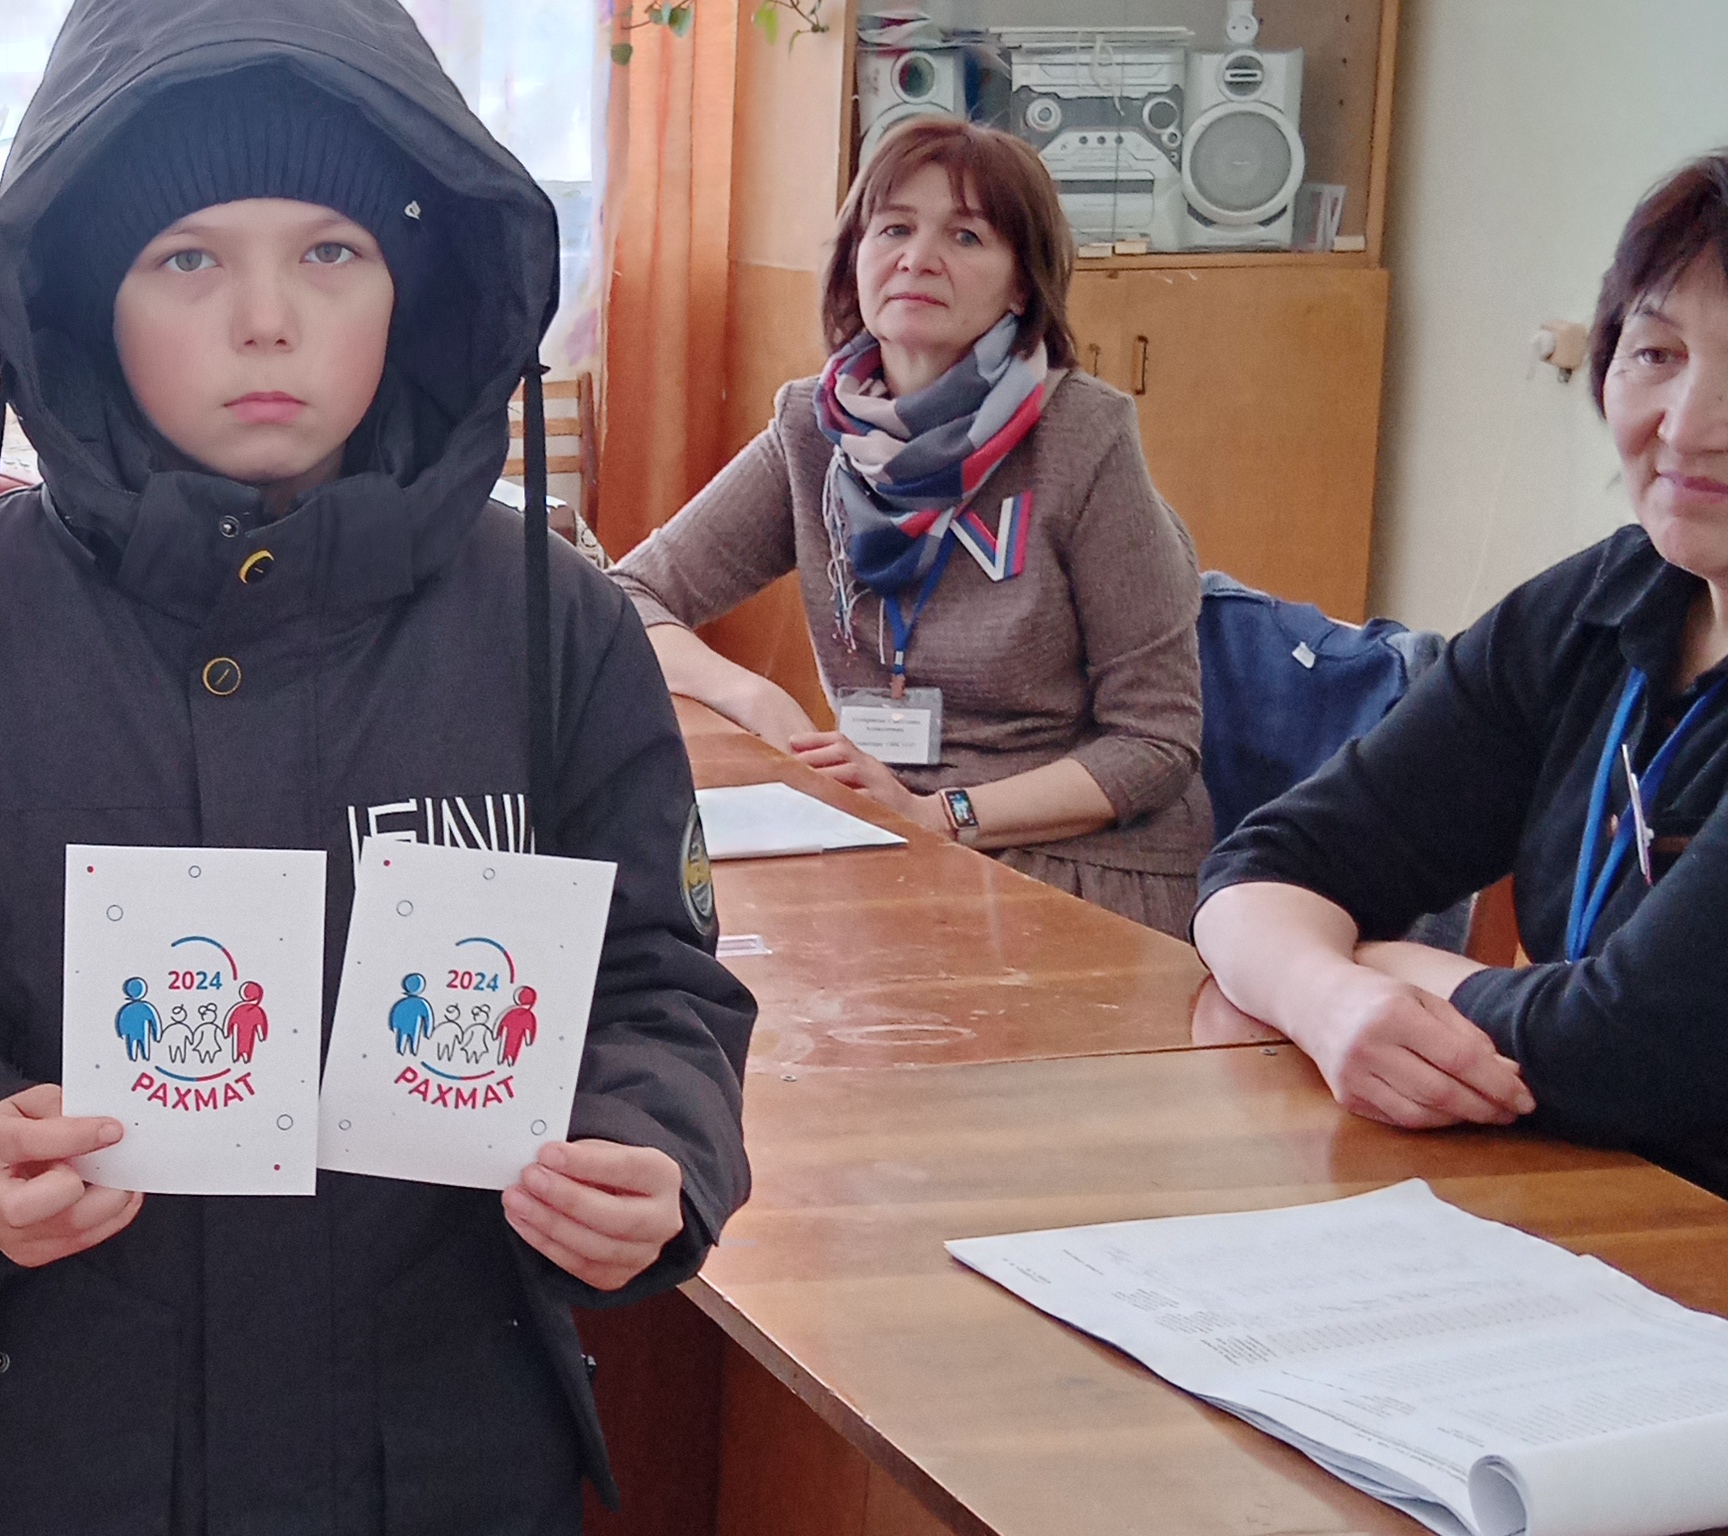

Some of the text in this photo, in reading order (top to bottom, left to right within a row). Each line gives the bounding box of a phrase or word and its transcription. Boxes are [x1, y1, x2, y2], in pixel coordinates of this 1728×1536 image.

[168, 970, 222, 990] 2024
[446, 969, 500, 992] 2024
[131, 1071, 256, 1112] РАХМАТ
[393, 1066, 515, 1110] РАХМАТ
